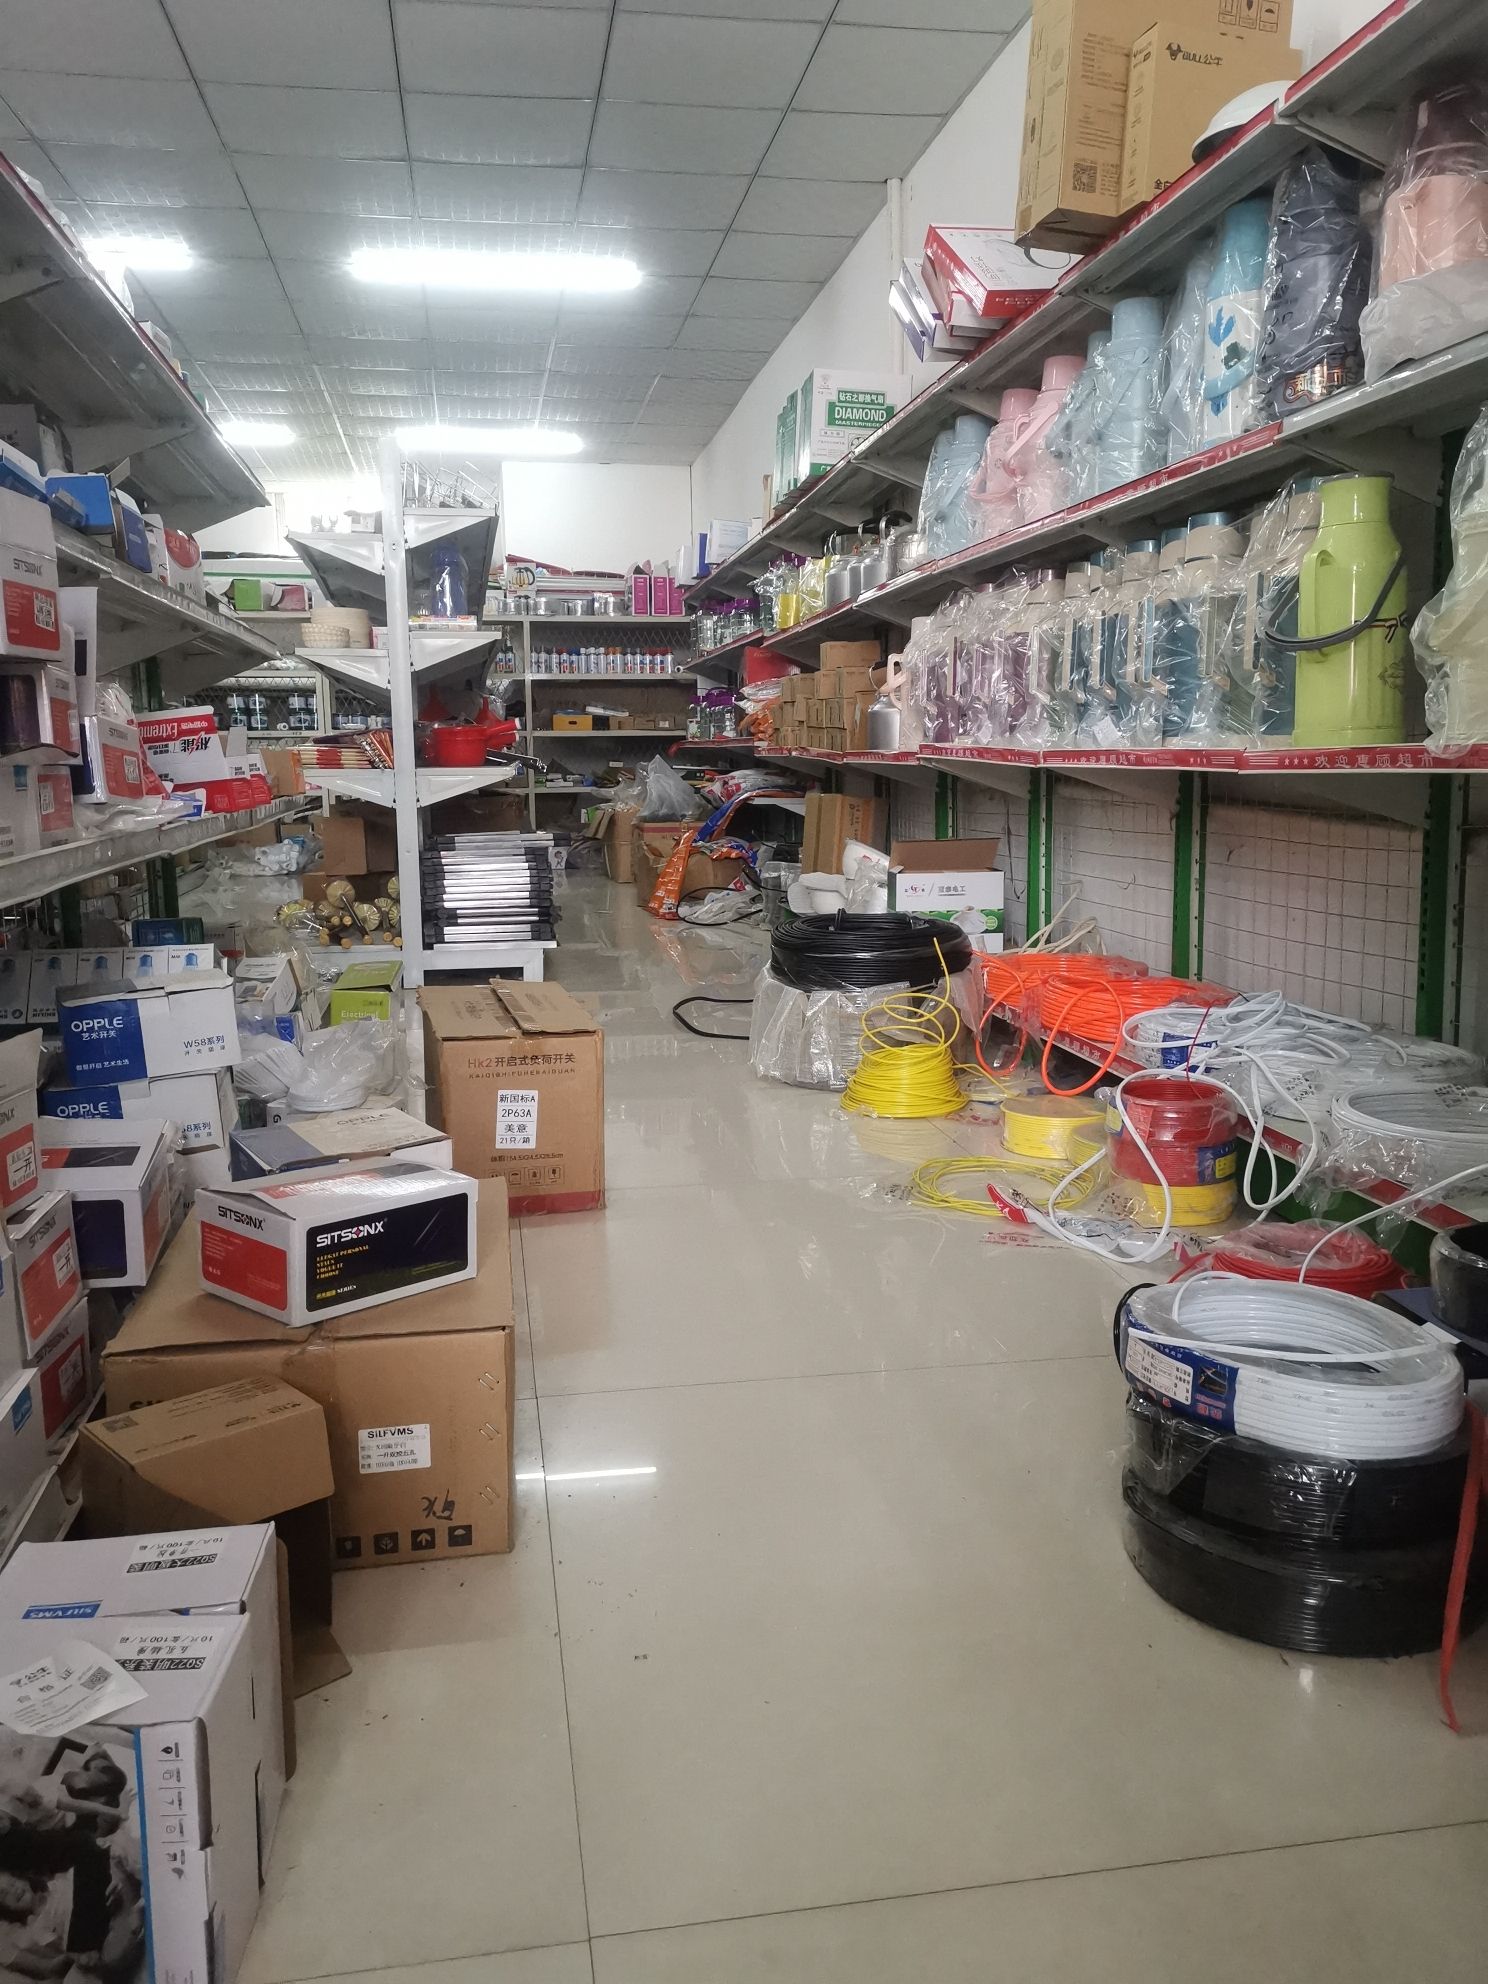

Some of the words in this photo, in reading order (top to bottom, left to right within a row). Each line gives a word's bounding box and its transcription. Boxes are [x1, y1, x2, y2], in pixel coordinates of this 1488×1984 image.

[834, 406, 887, 422] DIAMOND
[1313, 752, 1435, 769] 欢迎惠顾超市
[70, 1016, 124, 1032] OPPLE
[81, 1030, 118, 1041] 艺术开关
[183, 1034, 225, 1049] W58系列
[498, 1094, 537, 1104] 新国标A
[57, 1101, 111, 1117] OPPLE
[501, 1108, 532, 1118] 2P63A
[504, 1123, 529, 1134] 美意
[217, 1205, 265, 1232] SITSONX
[316, 1220, 385, 1248] SITSONX
[115, 1657, 206, 1672] SQ22明装系
